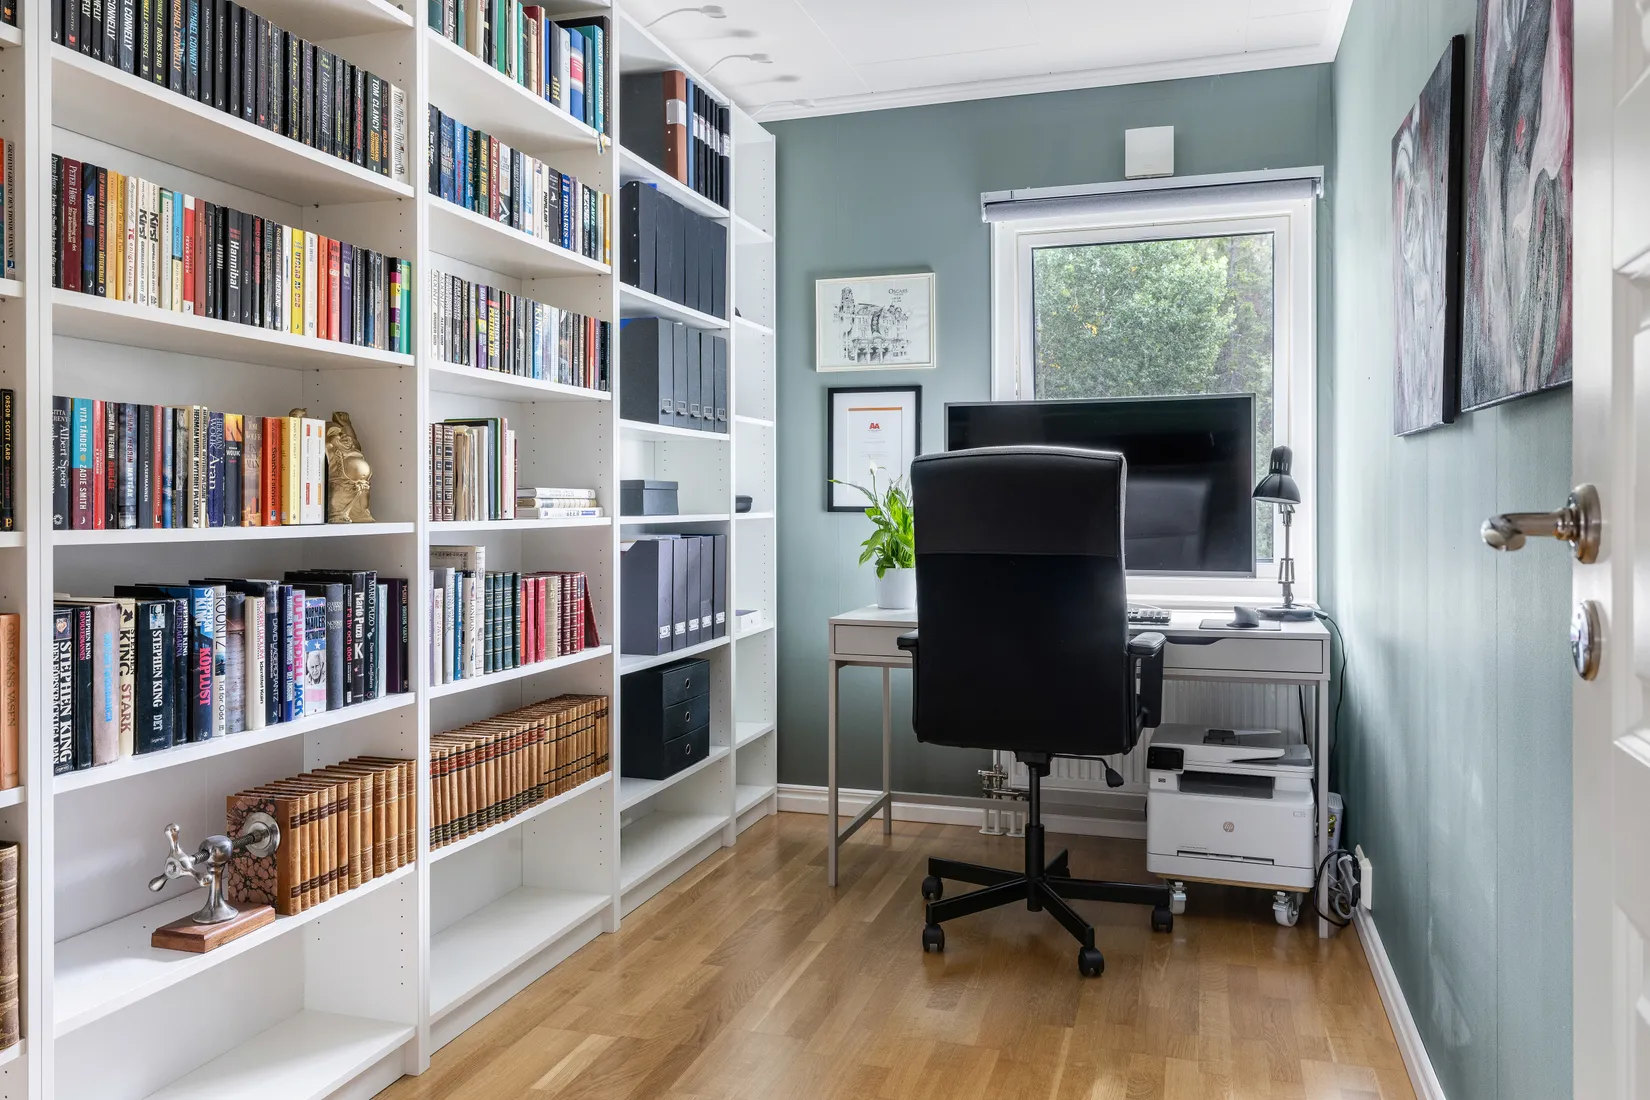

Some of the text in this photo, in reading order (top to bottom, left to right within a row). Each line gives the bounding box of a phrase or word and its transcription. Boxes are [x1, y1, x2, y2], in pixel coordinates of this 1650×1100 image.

[140, 209, 148, 240] Kirst
[150, 212, 158, 242] Kirst
[230, 240, 240, 290] Hannibal
[56, 424, 70, 488] Albert Speer
[210, 454, 223, 490] Äran
[354, 592, 364, 618] Mario
[354, 618, 364, 638] Puzo
[120, 630, 132, 734] KING STARK
[152, 630, 162, 731] STEPHEN KING DET
[200, 648, 212, 706] KÖPLUST
[294, 595, 304, 716] ULF LUNDELL JACK
[60, 642, 72, 762] STEPHEN KING
